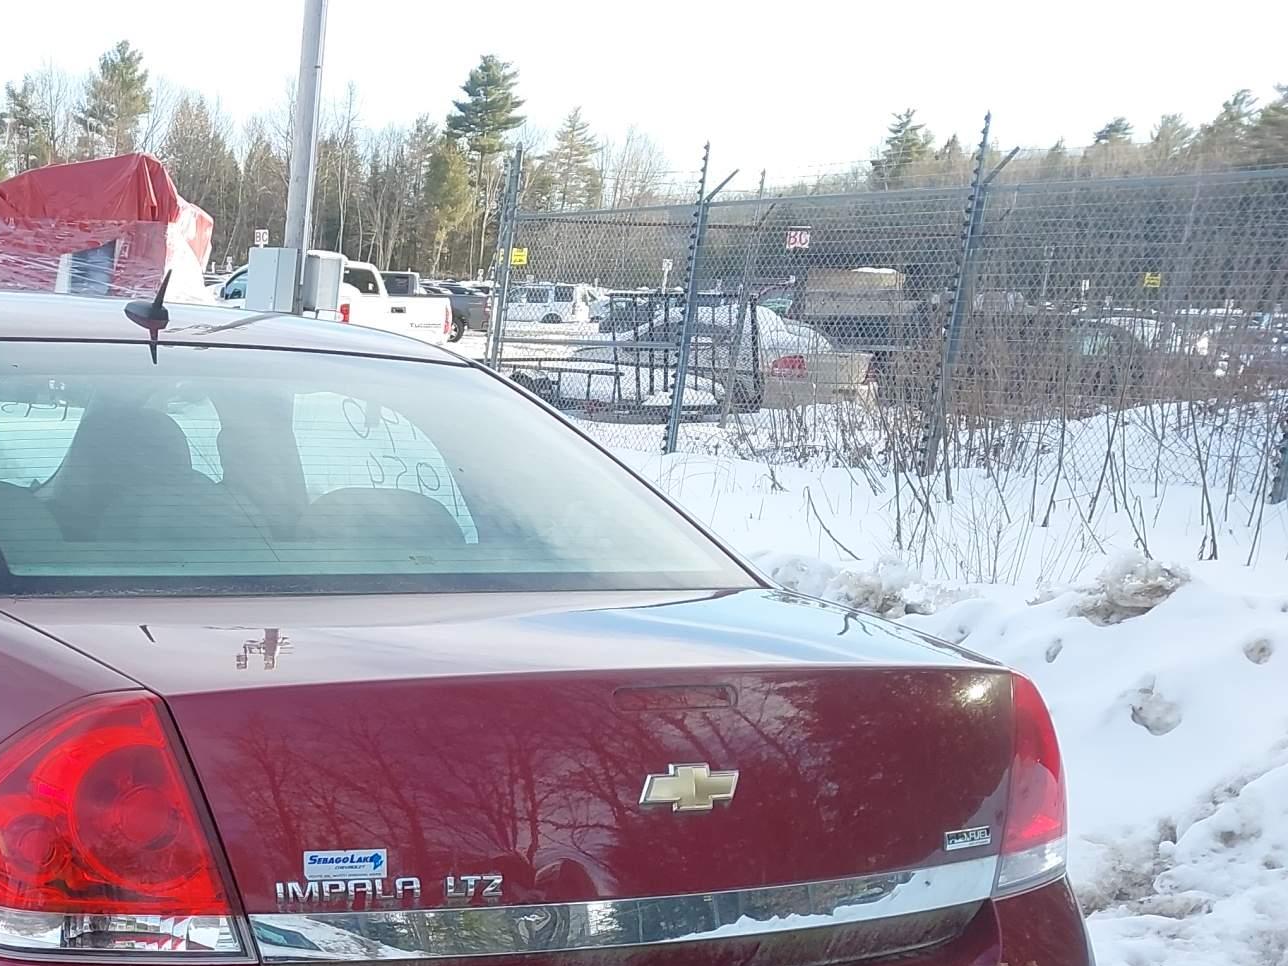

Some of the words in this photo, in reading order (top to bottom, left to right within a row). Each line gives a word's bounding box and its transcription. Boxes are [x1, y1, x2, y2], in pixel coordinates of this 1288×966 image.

[255, 231, 268, 243] BC
[275, 877, 421, 902] IMPALA
[446, 875, 504, 898] LTZ
